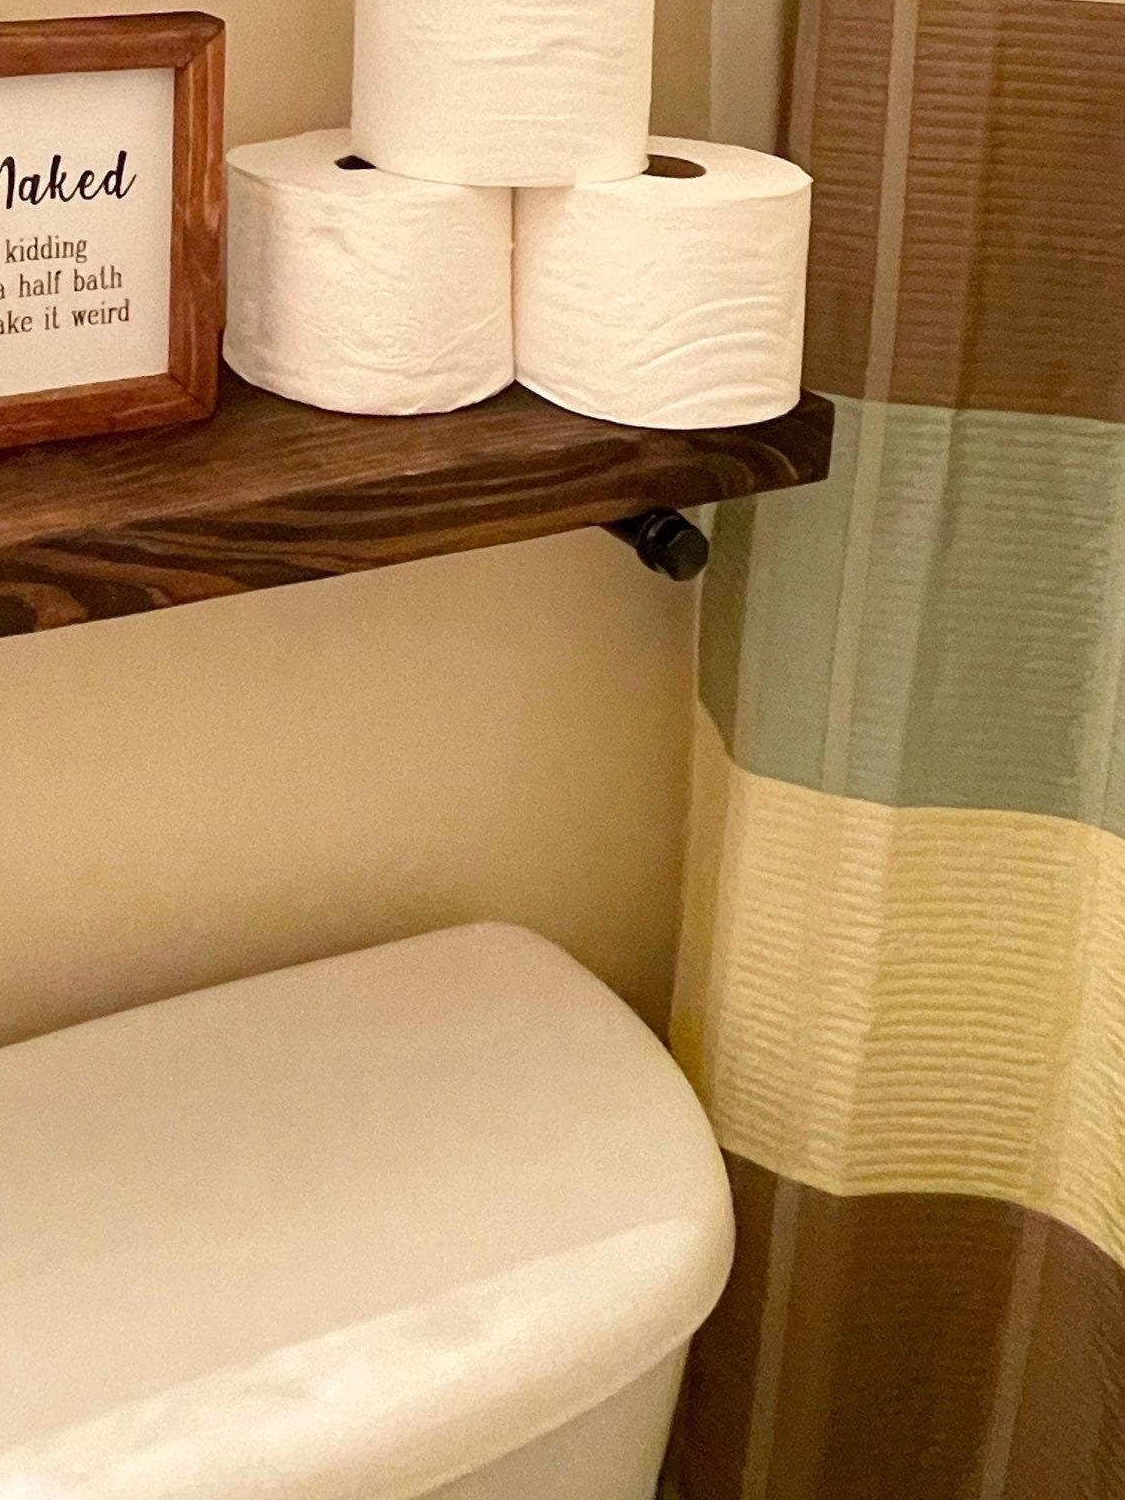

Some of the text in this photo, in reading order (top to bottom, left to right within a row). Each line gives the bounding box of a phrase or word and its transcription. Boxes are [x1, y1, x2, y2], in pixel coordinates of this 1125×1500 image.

[5, 235, 88, 264] kidding
[18, 270, 61, 298] half
[73, 265, 123, 292] bath
[43, 306, 60, 331] it
[71, 299, 131, 327] weird
